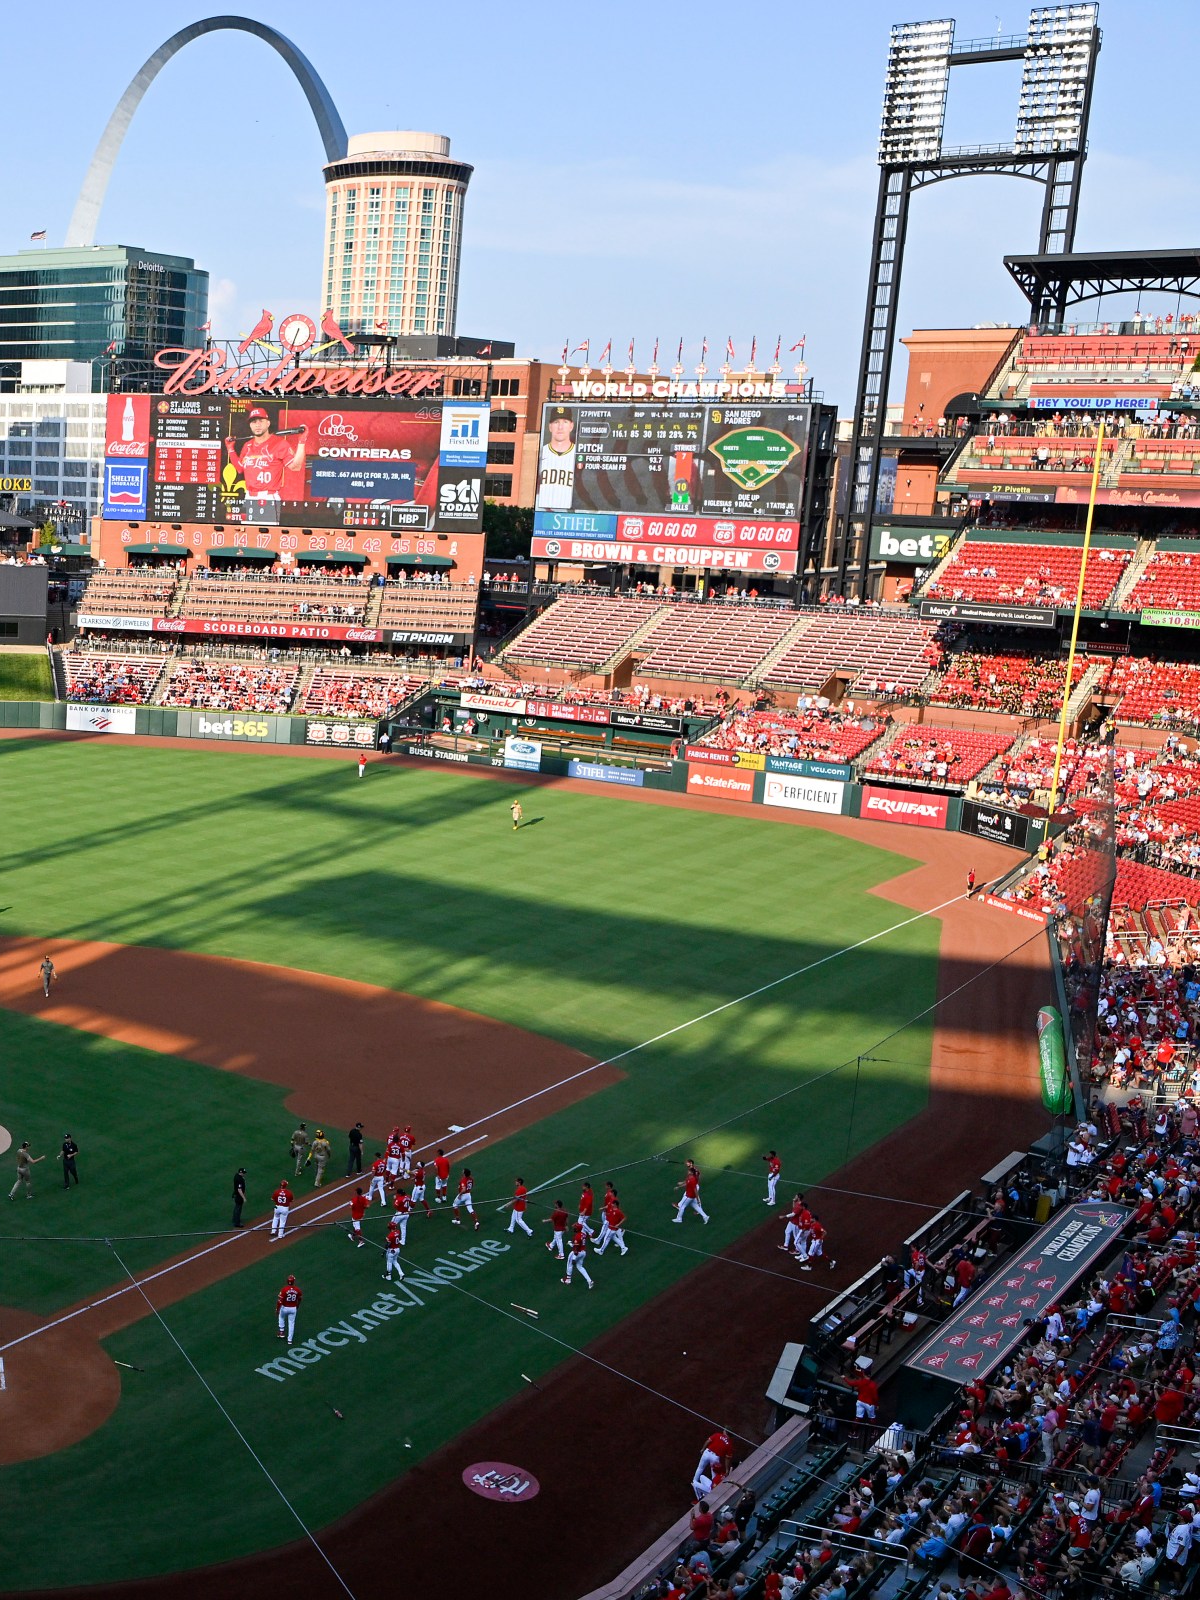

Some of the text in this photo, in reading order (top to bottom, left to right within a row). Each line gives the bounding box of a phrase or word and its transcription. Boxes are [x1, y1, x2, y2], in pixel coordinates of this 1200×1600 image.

[154, 348, 446, 395] Budweiser
[571, 380, 786, 397] WORLD CHAMPIONS
[1038, 399, 1149, 408] HEY YOU! UP HERE!
[108, 441, 148, 456] Coca-Cola
[318, 448, 411, 459] CONTRERAS
[578, 444, 603, 452] PITCH
[257, 472, 271, 483] 40
[440, 479, 480, 503] stl
[440, 503, 479, 512] TODAY
[399, 514, 419, 524] HBP
[552, 514, 598, 532] STIFEL
[626, 526, 640, 535] 66
[649, 522, 696, 537] GO GO GO
[717, 530, 732, 540] 66
[741, 526, 792, 543] GO GO GO
[571, 543, 749, 567] BROWN & CROUPPEN
[81, 618, 111, 626] CLARKSON
[157, 619, 186, 630] Coca-Cola
[204, 623, 329, 637] SCOREBOARD PATIO
[346, 629, 378, 640] Coca-Cola
[392, 632, 454, 643] 1ST PHORM
[465, 695, 522, 708] Schnucks
[198, 717, 268, 737] bet365
[409, 746, 469, 762] BUSCH STADIUM
[515, 744, 532, 753] Ford
[576, 765, 605, 778] STIFEL
[770, 760, 845, 775] VANTAGE vcu.com
[704, 776, 750, 791] State Farm
[767, 782, 838, 805] PERFICIENT
[867, 796, 938, 816] EQUIFAX
[977, 812, 994, 825] Mercy
[1032, 819, 1043, 829] 335'
[1040, 1220, 1084, 1256] WORLD SERIES
[1056, 1223, 1103, 1262] CHAMPIONS
[254, 1239, 511, 1382] mercy.net/NoLine
